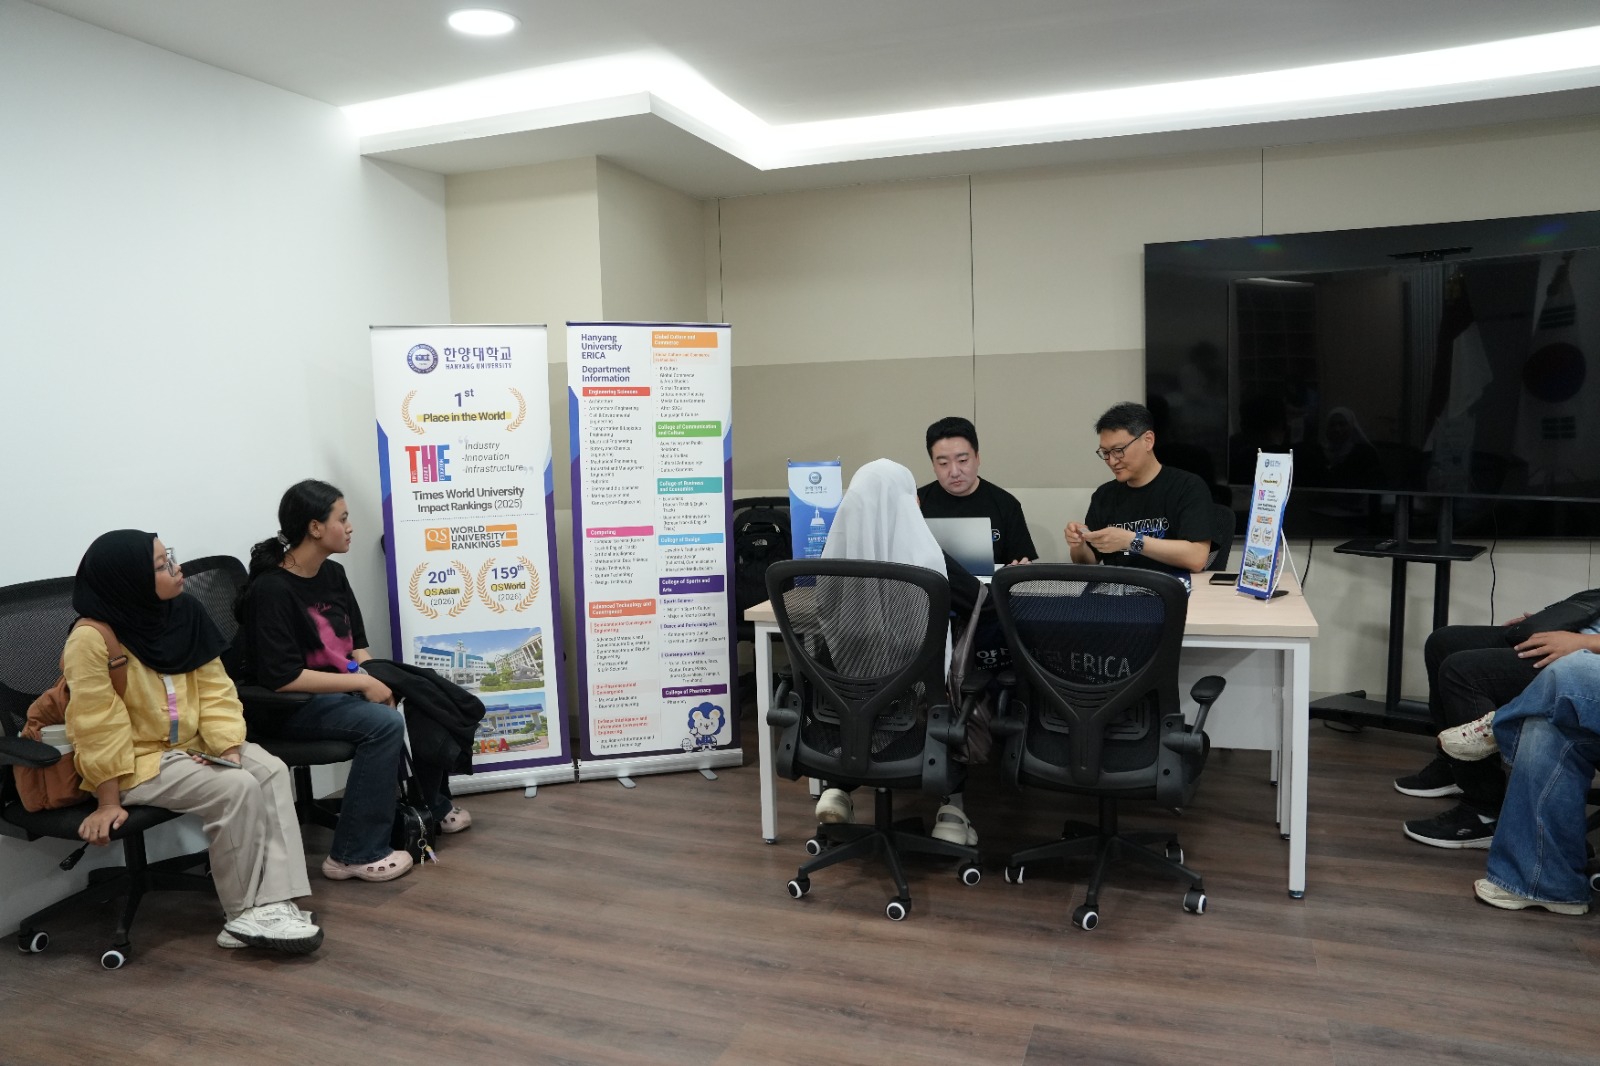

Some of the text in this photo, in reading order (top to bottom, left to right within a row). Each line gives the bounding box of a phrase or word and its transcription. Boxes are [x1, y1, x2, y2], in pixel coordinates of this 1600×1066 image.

[581, 334, 618, 343] Hanyang
[582, 342, 622, 352] University
[444, 346, 512, 362] 한양대학교
[582, 366, 630, 375] Department
[423, 411, 506, 422] Place in the World
[465, 442, 500, 451] Industry
[405, 444, 452, 483] THE
[412, 486, 524, 500] Times World University
[418, 499, 522, 514] Impact Rankings (2025)
[451, 525, 485, 534] WORLD
[1108, 517, 1170, 534] NYANG
[426, 529, 448, 543] QS
[451, 532, 505, 542] UNIVERSITY
[452, 540, 501, 550] RANKINGS
[428, 568, 456, 584] 20th
[491, 564, 524, 580] 159th
[491, 582, 526, 592] QS World
[424, 588, 460, 597] QS Asian
[430, 597, 455, 606] (2026)
[1070, 652, 1131, 678] ERICA
